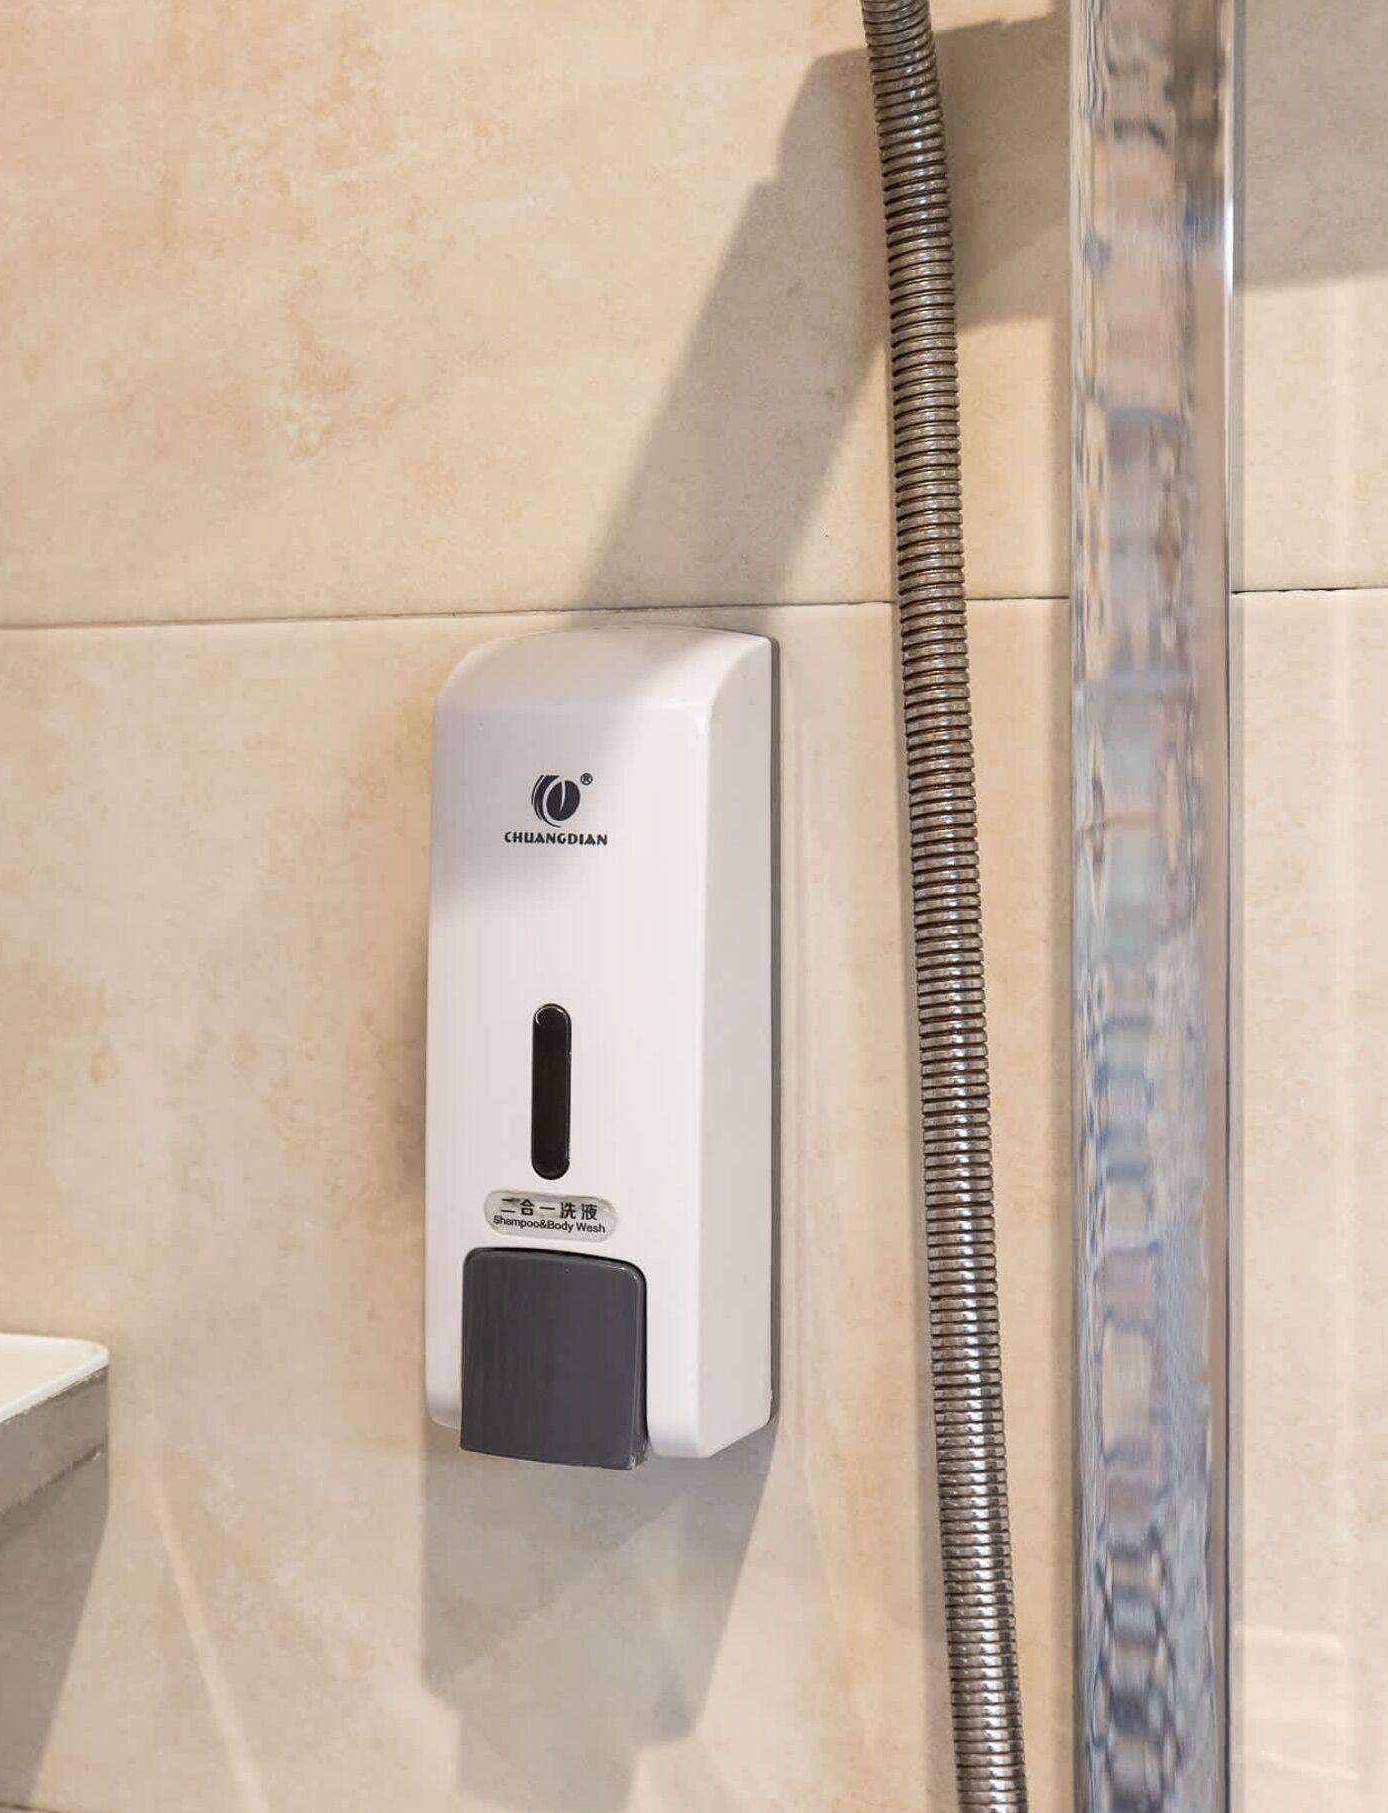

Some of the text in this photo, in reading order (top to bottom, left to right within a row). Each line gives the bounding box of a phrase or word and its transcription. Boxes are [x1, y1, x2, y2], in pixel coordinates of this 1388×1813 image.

[504, 831, 608, 846] CHUANGDIAN
[500, 1198, 598, 1221] 二合一洗液
[493, 1215, 574, 1233] Shampoo&Body
